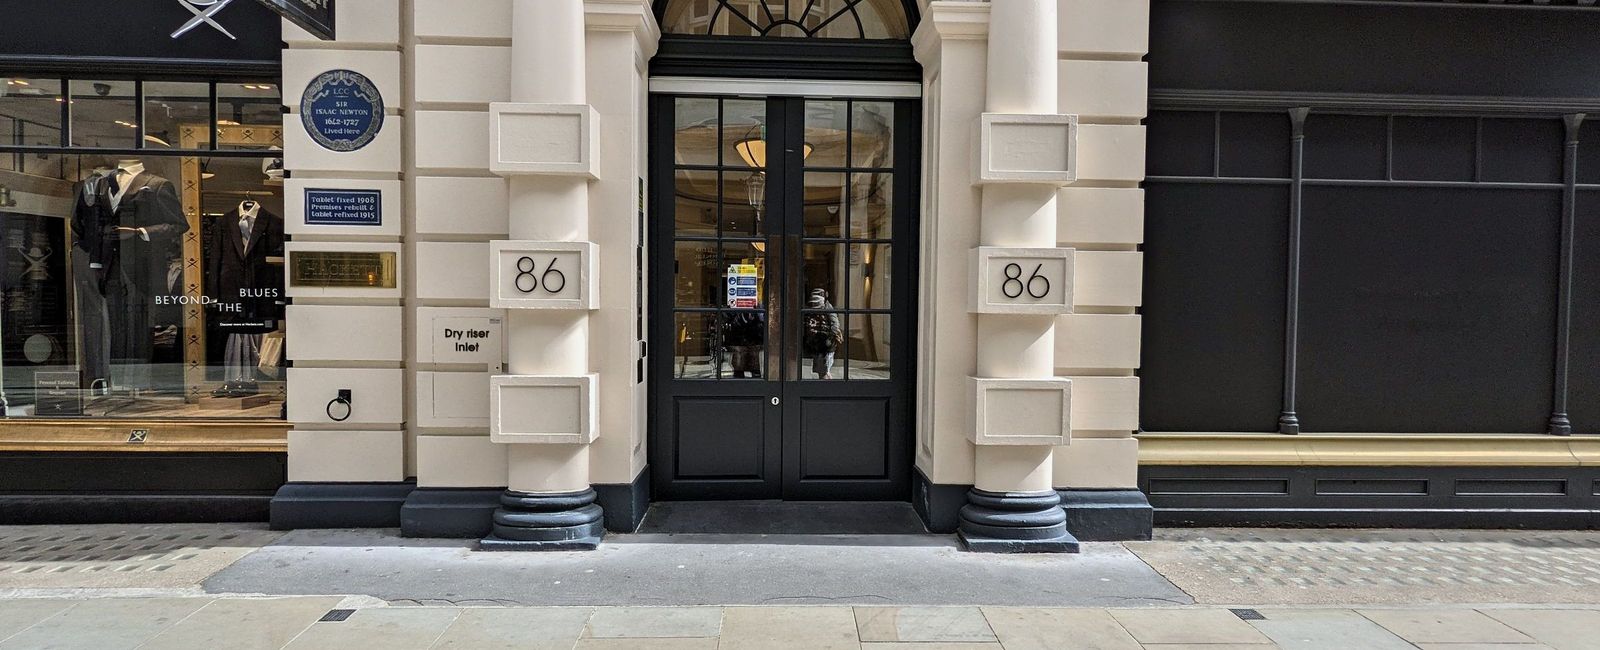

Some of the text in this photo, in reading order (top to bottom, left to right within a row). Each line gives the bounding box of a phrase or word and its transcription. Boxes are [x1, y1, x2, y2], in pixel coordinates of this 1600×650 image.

[325, 118, 360, 126] 1642-1727
[336, 196, 355, 204] fixed
[334, 211, 359, 219] refixed
[360, 211, 375, 219] 1915
[515, 256, 566, 293] 86
[1002, 262, 1050, 299] 86
[239, 288, 279, 298] BLUES
[155, 295, 210, 305] BEYOND
[217, 302, 242, 312] THE
[444, 328, 490, 340] Dry riser
